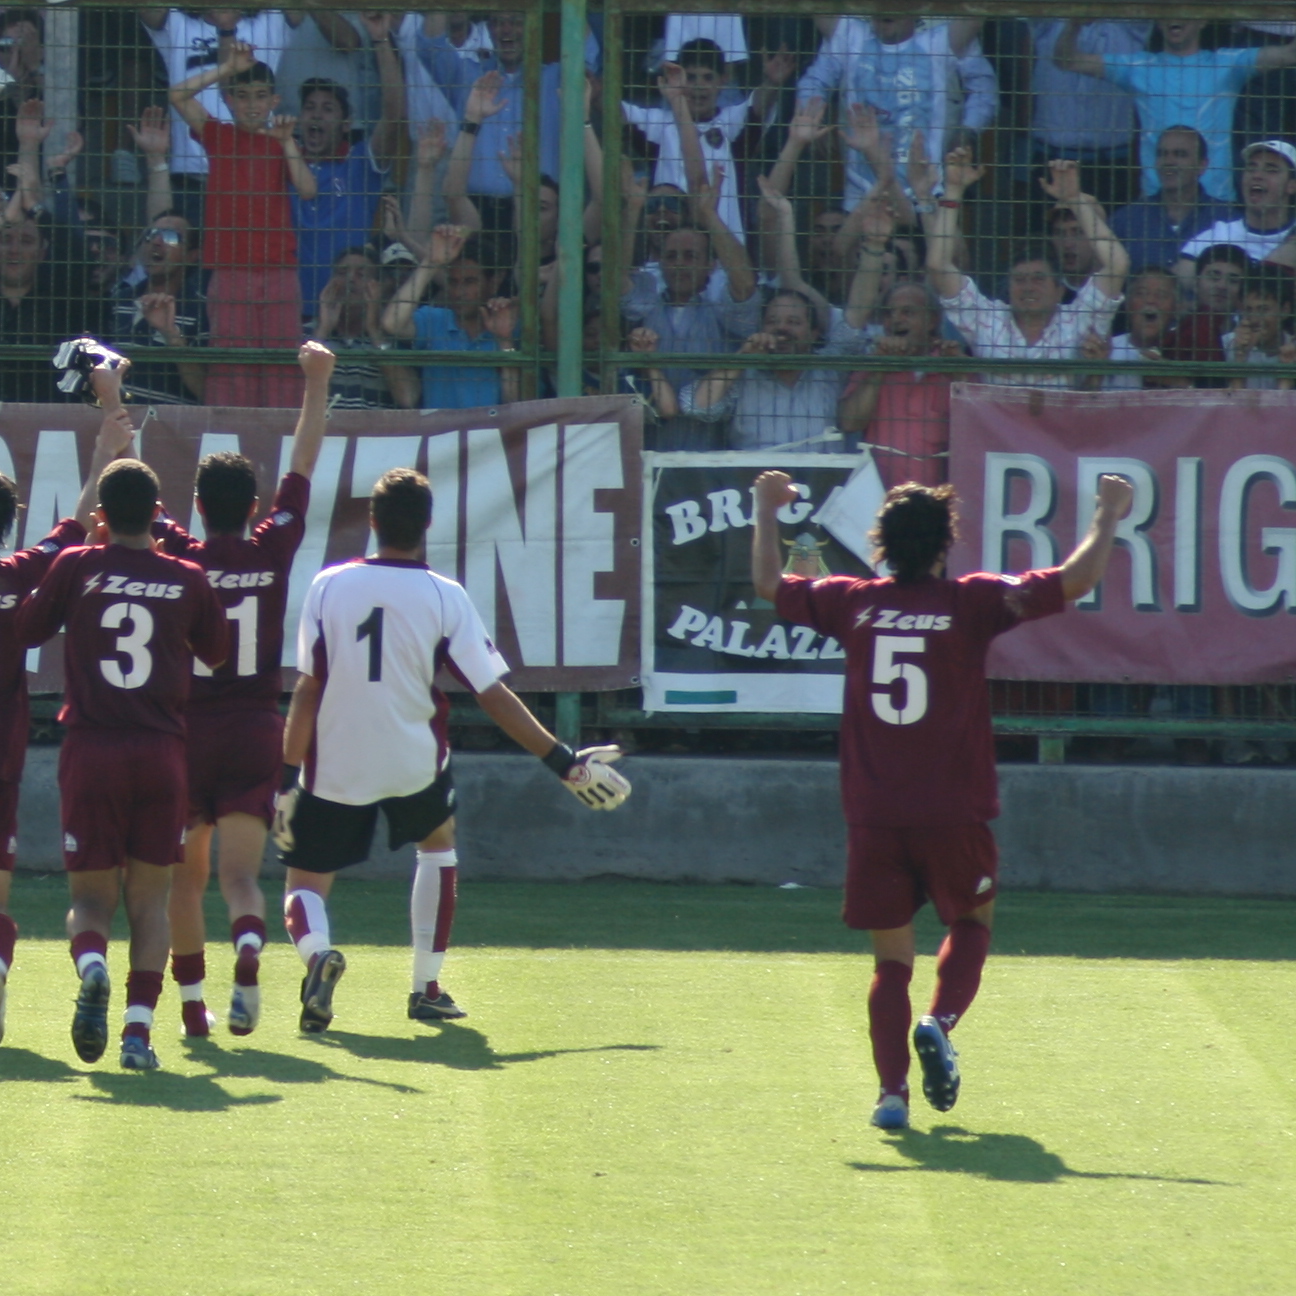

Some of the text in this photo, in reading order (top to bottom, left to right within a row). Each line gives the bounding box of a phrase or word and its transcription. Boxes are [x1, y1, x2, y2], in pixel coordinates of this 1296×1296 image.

[100, 575, 185, 600] Zeus
[874, 609, 952, 632] Zeus
[98, 601, 155, 690] 3
[192, 595, 259, 677] 1
[355, 606, 385, 683] 1
[666, 604, 846, 661] PALAZZ
[870, 634, 929, 726] 5
